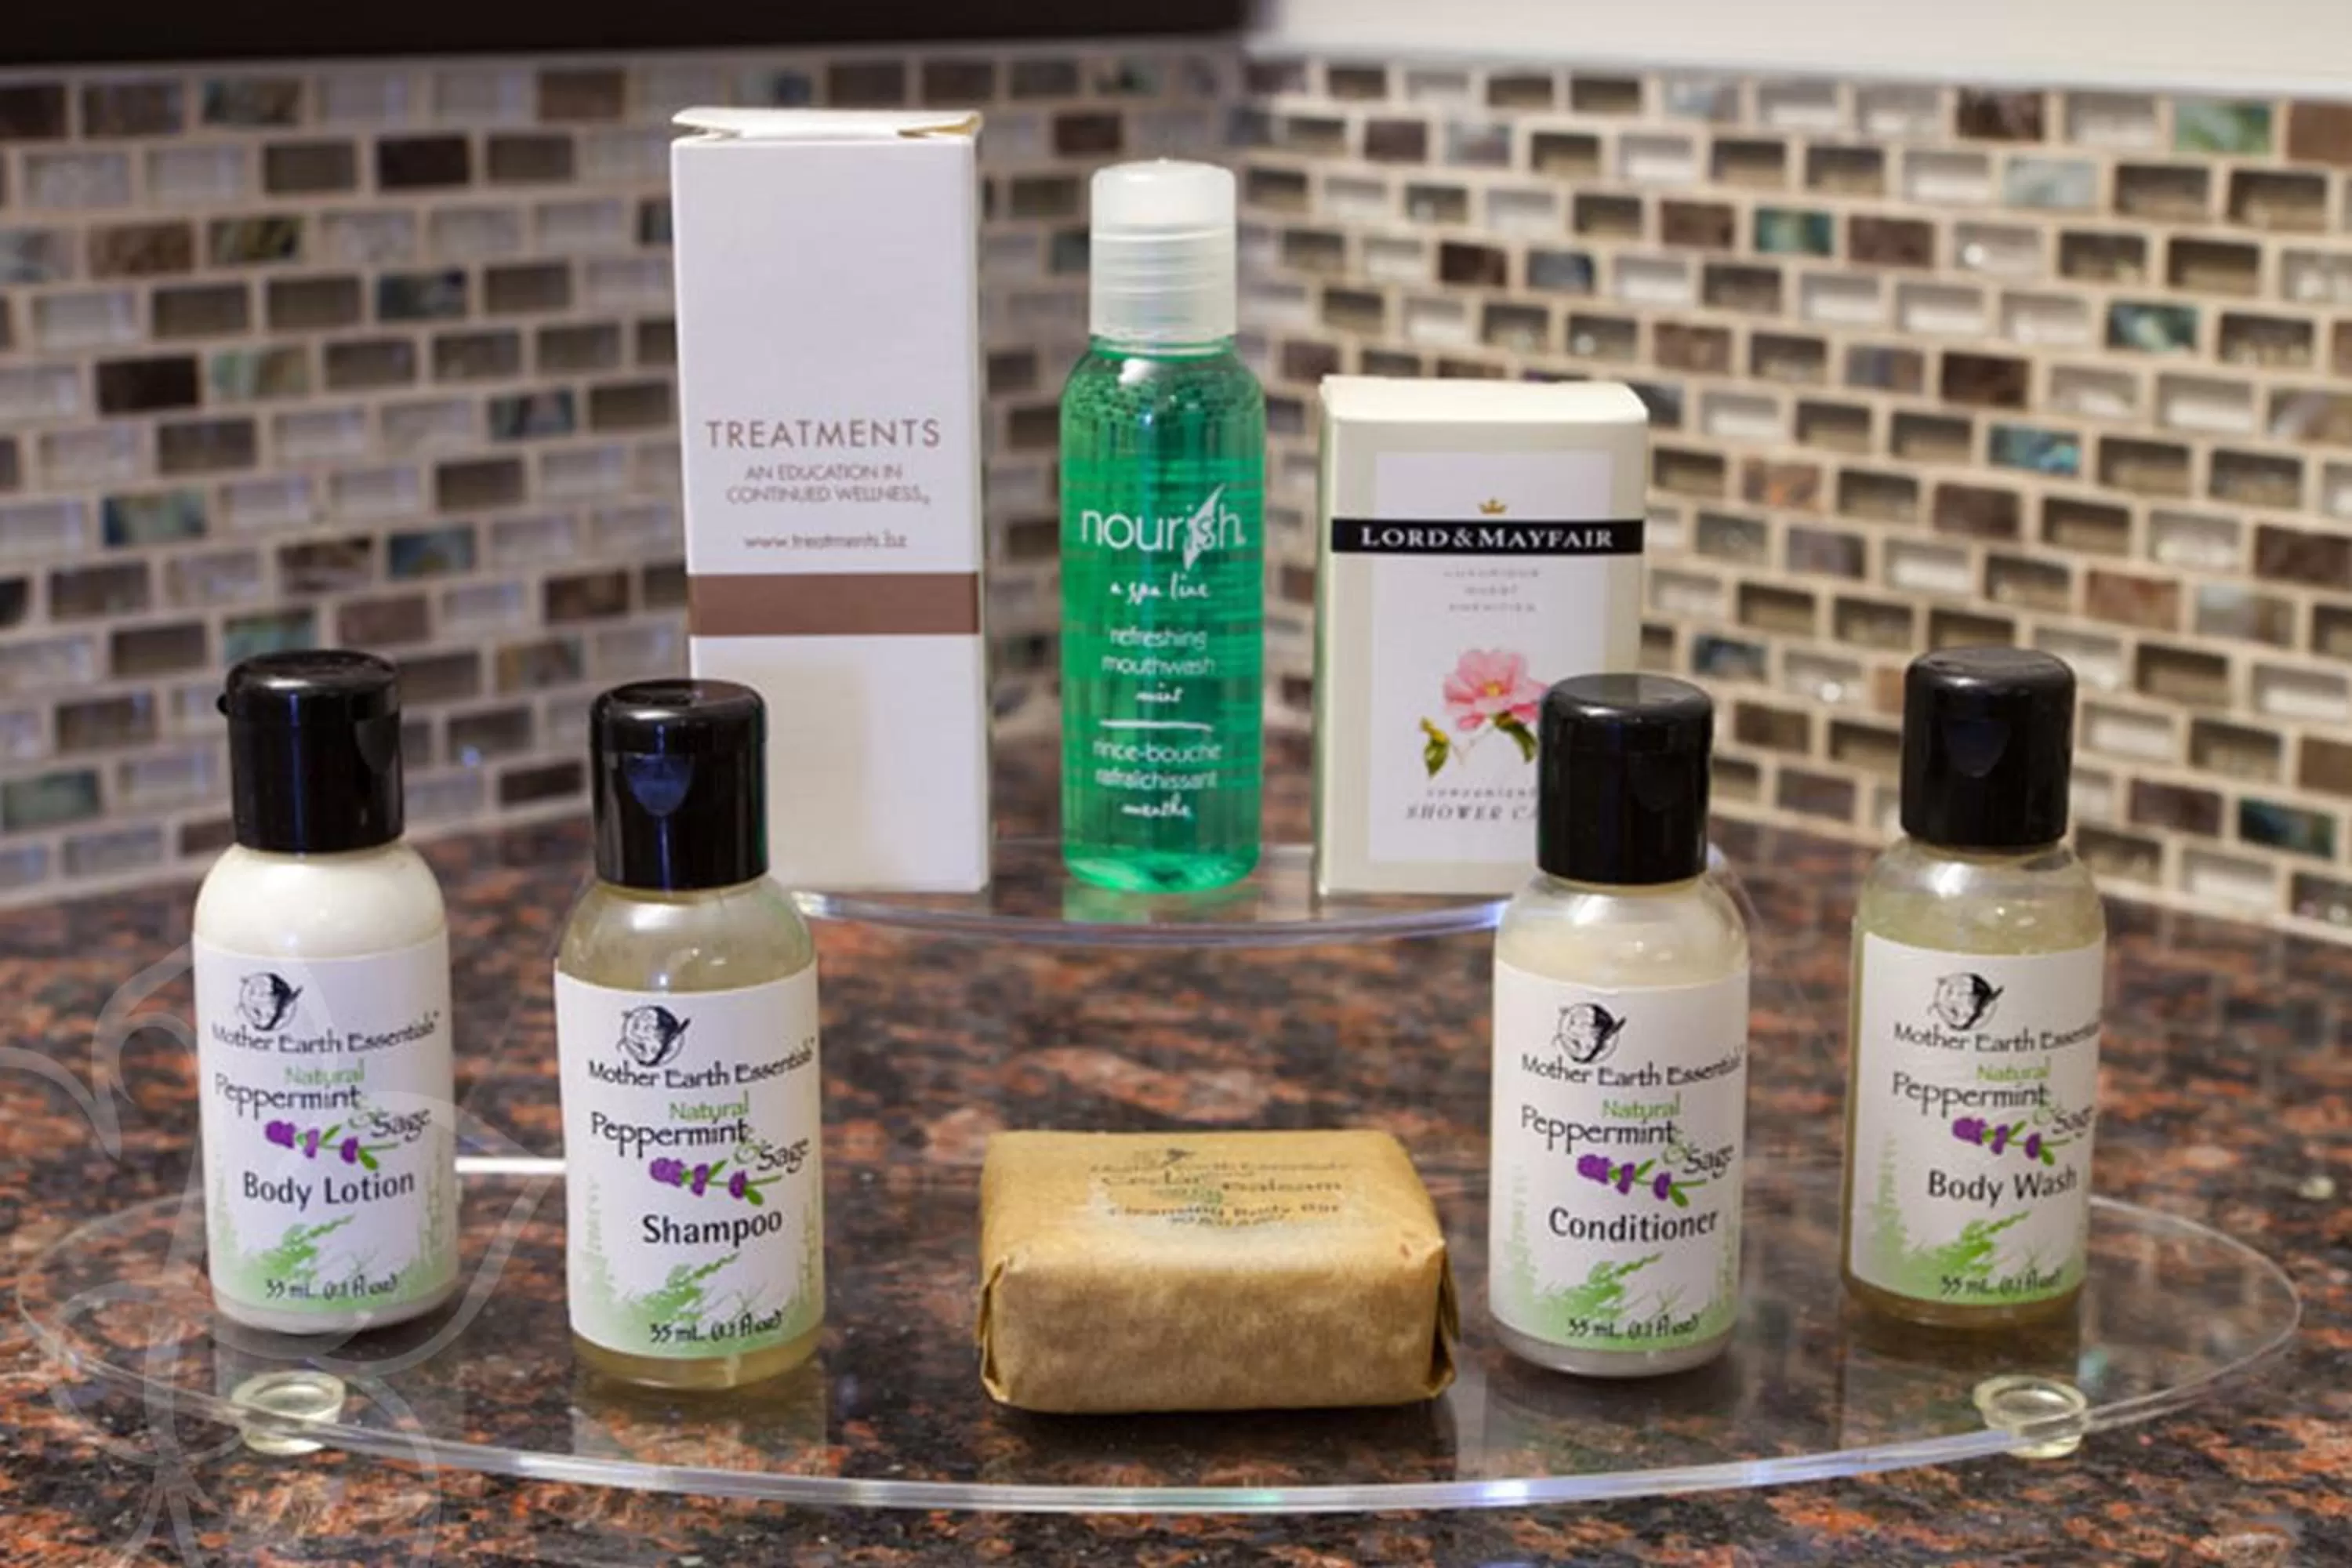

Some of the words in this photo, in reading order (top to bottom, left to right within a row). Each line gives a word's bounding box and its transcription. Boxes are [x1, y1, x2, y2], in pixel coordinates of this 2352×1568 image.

[705, 418, 941, 448] TREATMENTS
[745, 466, 772, 481] AN
[777, 464, 878, 481] EDUCATION
[883, 464, 903, 480] IN
[726, 485, 831, 504] CONTINUED
[834, 484, 921, 503] WELLNESS
[1080, 503, 1242, 551] nourish
[212, 1022, 274, 1051] Mother
[278, 1028, 343, 1054] Earth
[1893, 1022, 1972, 1051] Mother
[1974, 1026, 2036, 1052] Earth
[283, 1058, 365, 1085] Natural
[589, 1059, 660, 1087] Mother
[666, 1060, 731, 1088] Earth
[1521, 1053, 1593, 1083] Mother
[1597, 1061, 1662, 1086] Earth
[1976, 1057, 2051, 1081] Natural
[214, 1071, 362, 1120] Peppermint
[669, 1090, 750, 1120] Natural
[1602, 1091, 1682, 1119] Natural
[1892, 1070, 2049, 1119] Peppermint
[370, 1109, 432, 1143] Sage
[591, 1110, 750, 1159] Peppermint
[1521, 1105, 1677, 1155] Peppermint
[757, 1138, 811, 1174] Sage
[243, 1171, 313, 1212] Body
[324, 1171, 416, 1206] Lotion
[1928, 1169, 2004, 1209] Body
[2013, 1166, 2078, 1201] Wash
[642, 1210, 783, 1249] Shampoo
[1548, 1206, 1720, 1243] Conditioner
